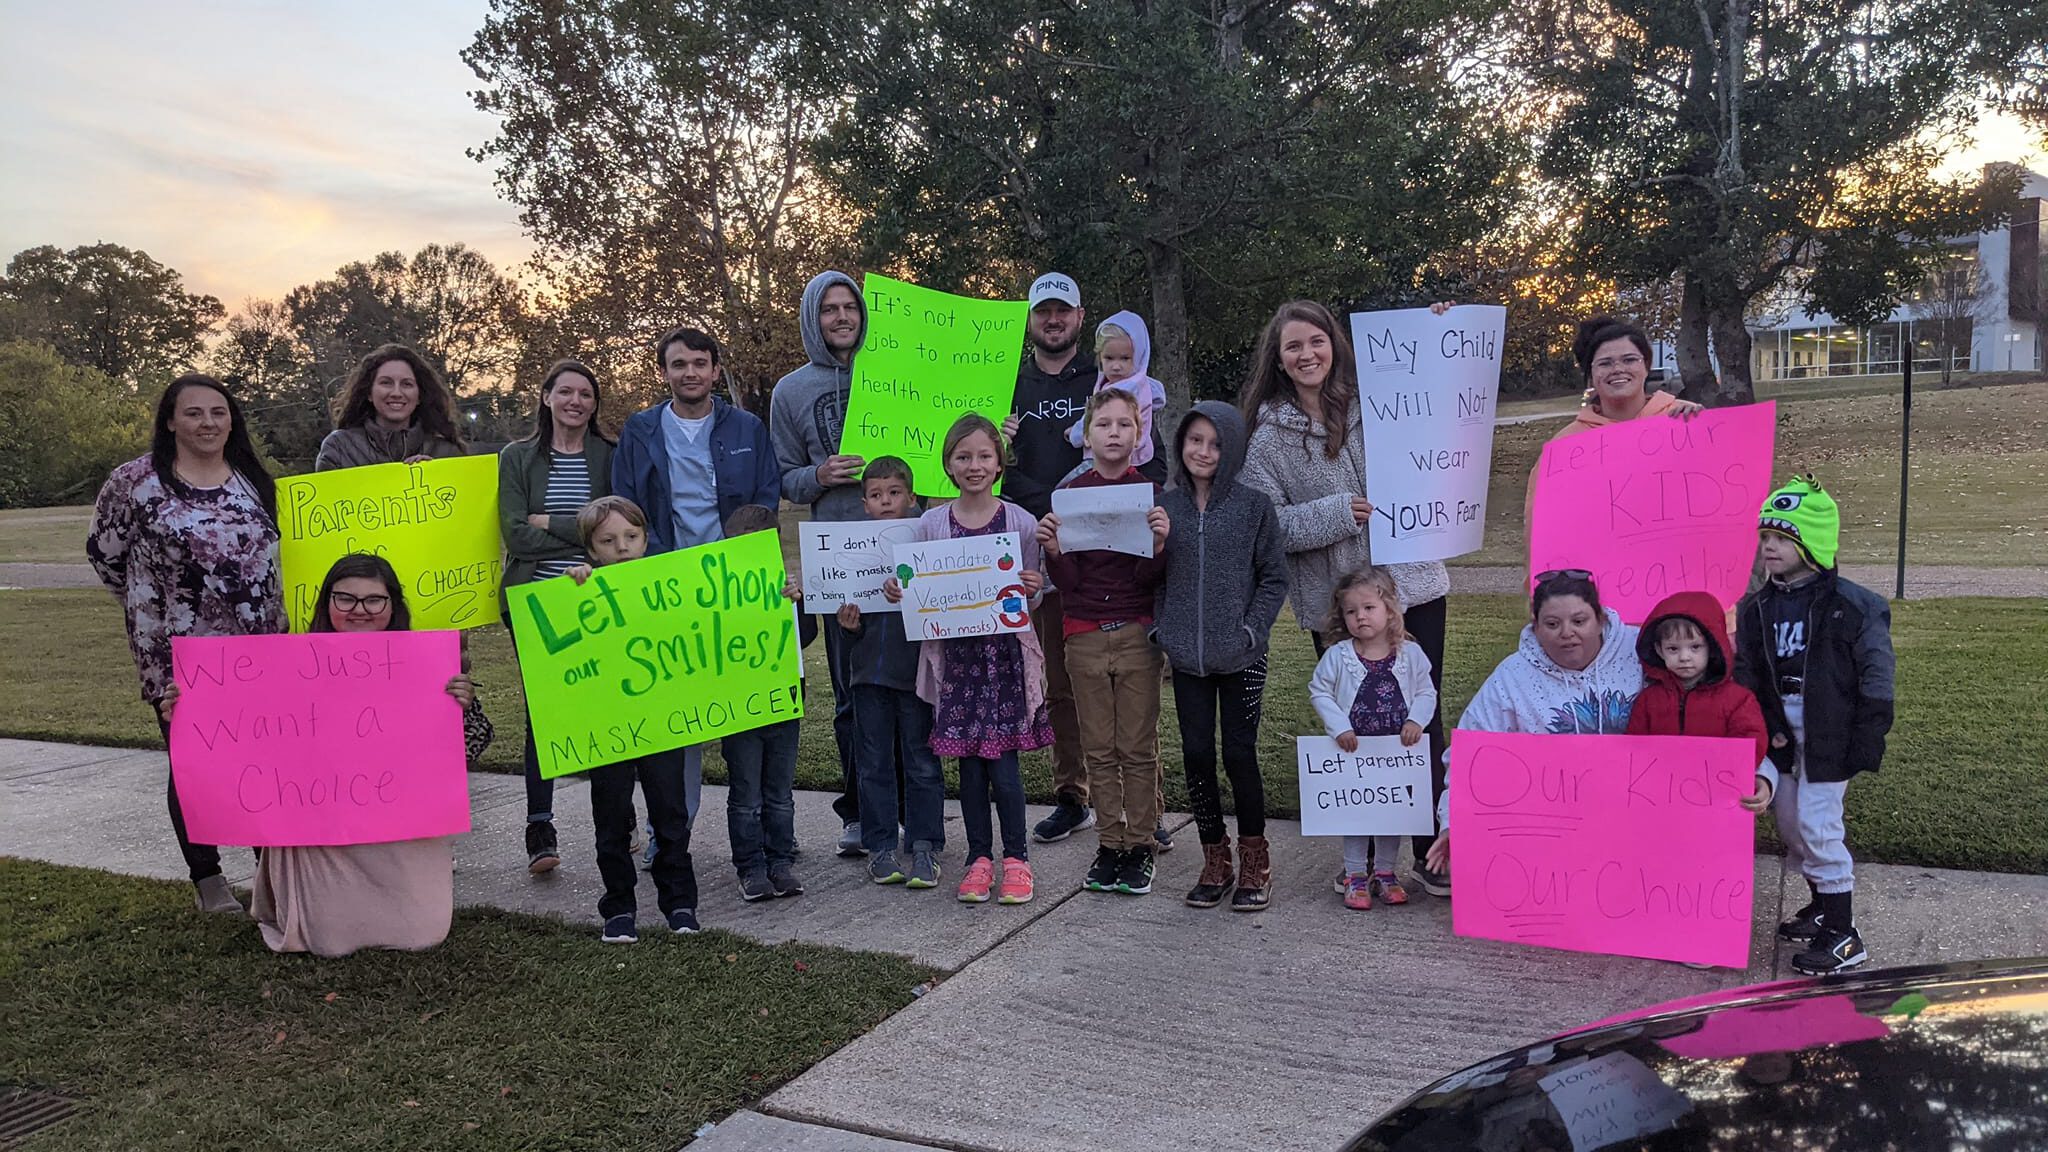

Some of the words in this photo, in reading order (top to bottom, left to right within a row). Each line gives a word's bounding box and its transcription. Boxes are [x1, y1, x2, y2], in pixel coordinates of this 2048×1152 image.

[1036, 280, 1069, 293] PING
[870, 291, 911, 317] It's
[924, 310, 956, 327] not
[971, 318, 1015, 343] your
[864, 331, 899, 352] job
[916, 343, 938, 362] to
[953, 349, 1006, 365] make
[1441, 329, 1495, 359] Child
[862, 371, 920, 401] health
[932, 392, 994, 409] choices
[1368, 392, 1432, 422] Will
[1457, 386, 1488, 419] Not
[859, 412, 889, 438] for
[1546, 437, 1609, 478] Let
[289, 466, 457, 540] Parents
[1610, 463, 1750, 531] KIDS
[1374, 500, 1449, 538] YOUR
[1456, 500, 1480, 526] Fear
[817, 534, 830, 550] I
[844, 537, 877, 550] don't
[913, 546, 992, 572] Mandate
[417, 560, 499, 598] CHOICE!
[821, 567, 847, 580] like
[856, 566, 893, 577] masks
[526, 575, 627, 655] Let
[641, 578, 682, 611] us
[696, 552, 785, 611] Show
[806, 593, 815, 601] or
[821, 590, 845, 602] being
[914, 581, 999, 612] Vegetables
[922, 619, 951, 639] (Not
[957, 615, 999, 634] masks)
[174, 648, 263, 690] We
[298, 640, 404, 681] Just
[564, 657, 600, 686] our
[620, 612, 793, 696] Smiles!
[357, 707, 384, 738] a
[551, 718, 652, 770] MASK
[667, 685, 799, 735] CHOICE!
[1306, 753, 1345, 775] Let
[1355, 752, 1425, 777] parents
[1469, 745, 1592, 807] Our
[1628, 753, 1741, 810] Kids
[237, 764, 400, 814] Choice
[1317, 784, 1414, 810] CHOOSE!
[1484, 852, 1586, 913] Our
[1596, 861, 1746, 921] Choice
